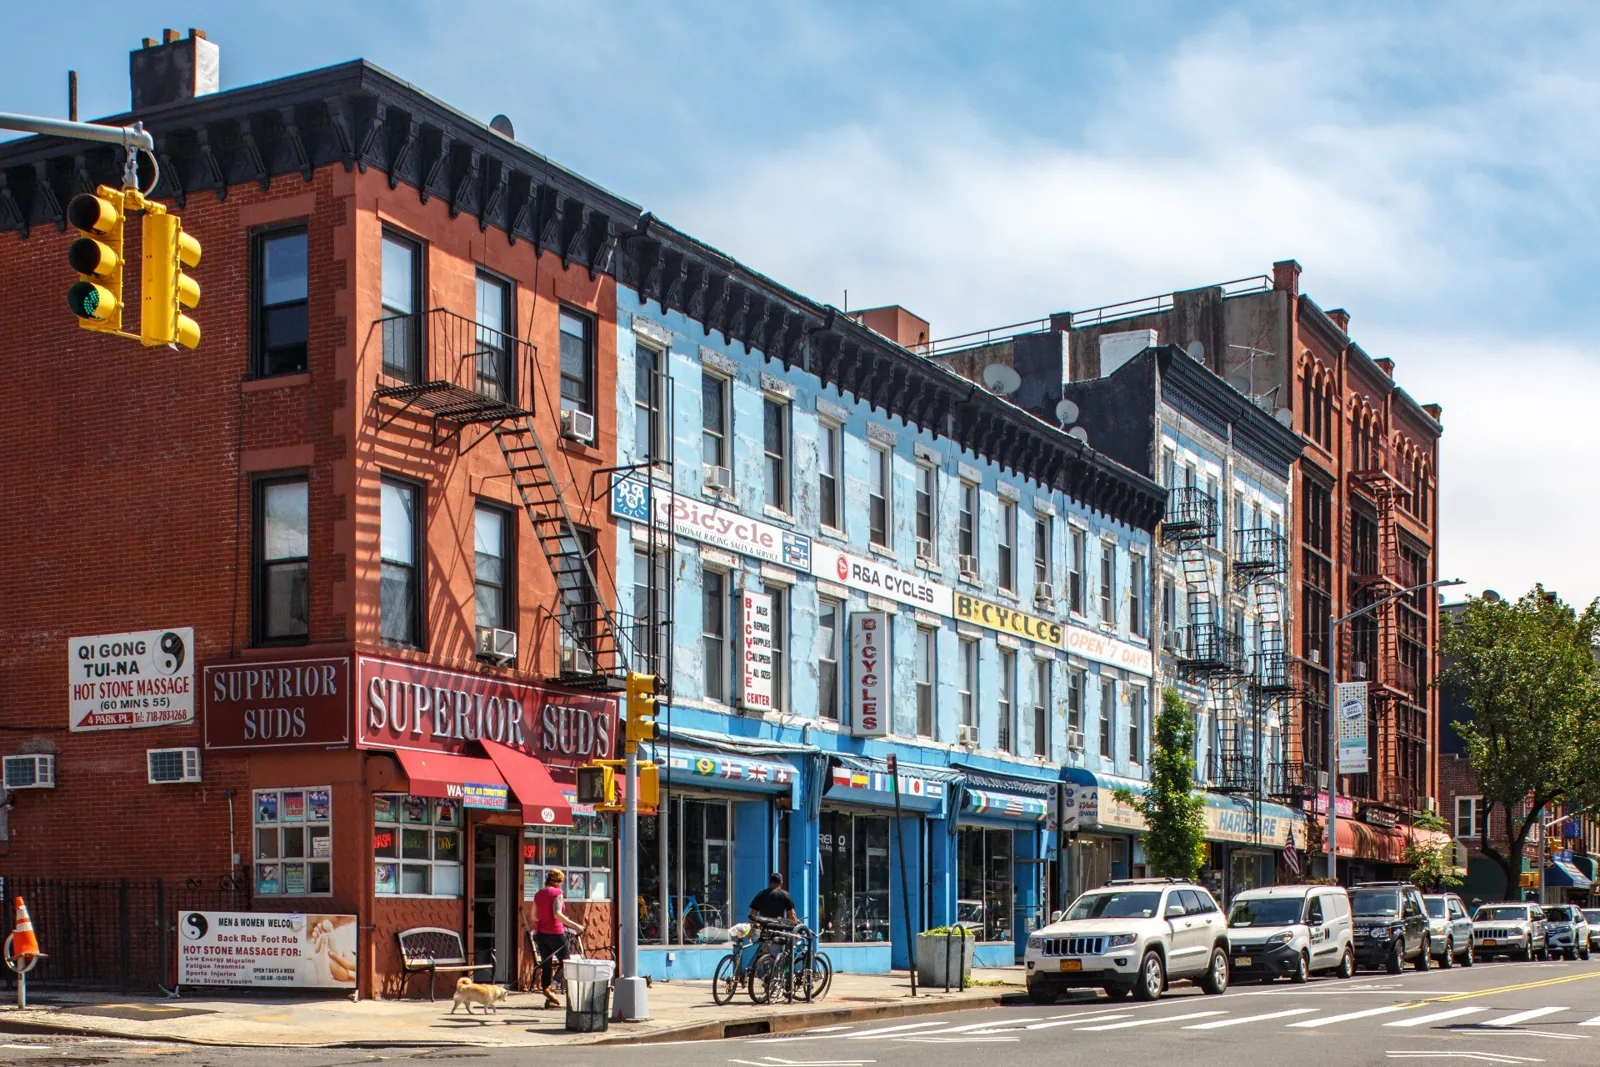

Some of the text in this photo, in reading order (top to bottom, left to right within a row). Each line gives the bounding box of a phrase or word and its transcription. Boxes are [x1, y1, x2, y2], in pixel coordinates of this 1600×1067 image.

[660, 495, 774, 548] Bicycle
[704, 532, 728, 546] RACING
[730, 540, 748, 552] SALES
[756, 549, 778, 562] SERVICE
[852, 563, 934, 603] R&A CYCLES
[756, 606, 768, 616] SALES
[754, 621, 770, 632] REPAIRS
[78, 641, 146, 660] QI GONG
[753, 638, 770, 648] SUPPLIES
[1069, 632, 1149, 669] OPEN 7 DAYS
[84, 660, 140, 678] TUI-NA
[861, 618, 878, 730] BICYCLES
[74, 676, 189, 701] HOT STONE MASSAGE
[214, 665, 337, 702] SUPERIOR
[100, 700, 117, 712] (60
[152, 697, 170, 708] 55)
[746, 692, 770, 706] CENTER
[88, 716, 93, 724] 4
[96, 715, 116, 724] PARK
[120, 714, 131, 723] PL.
[244, 707, 306, 740] SUDS
[368, 676, 610, 758] SUPERIOR SUDS
[218, 918, 293, 928] MEN & WOMEN WELCO
[218, 934, 238, 942] Back
[261, 935, 280, 943] Foot
[184, 946, 301, 956] HOT STONE MASSAGE FOR:
